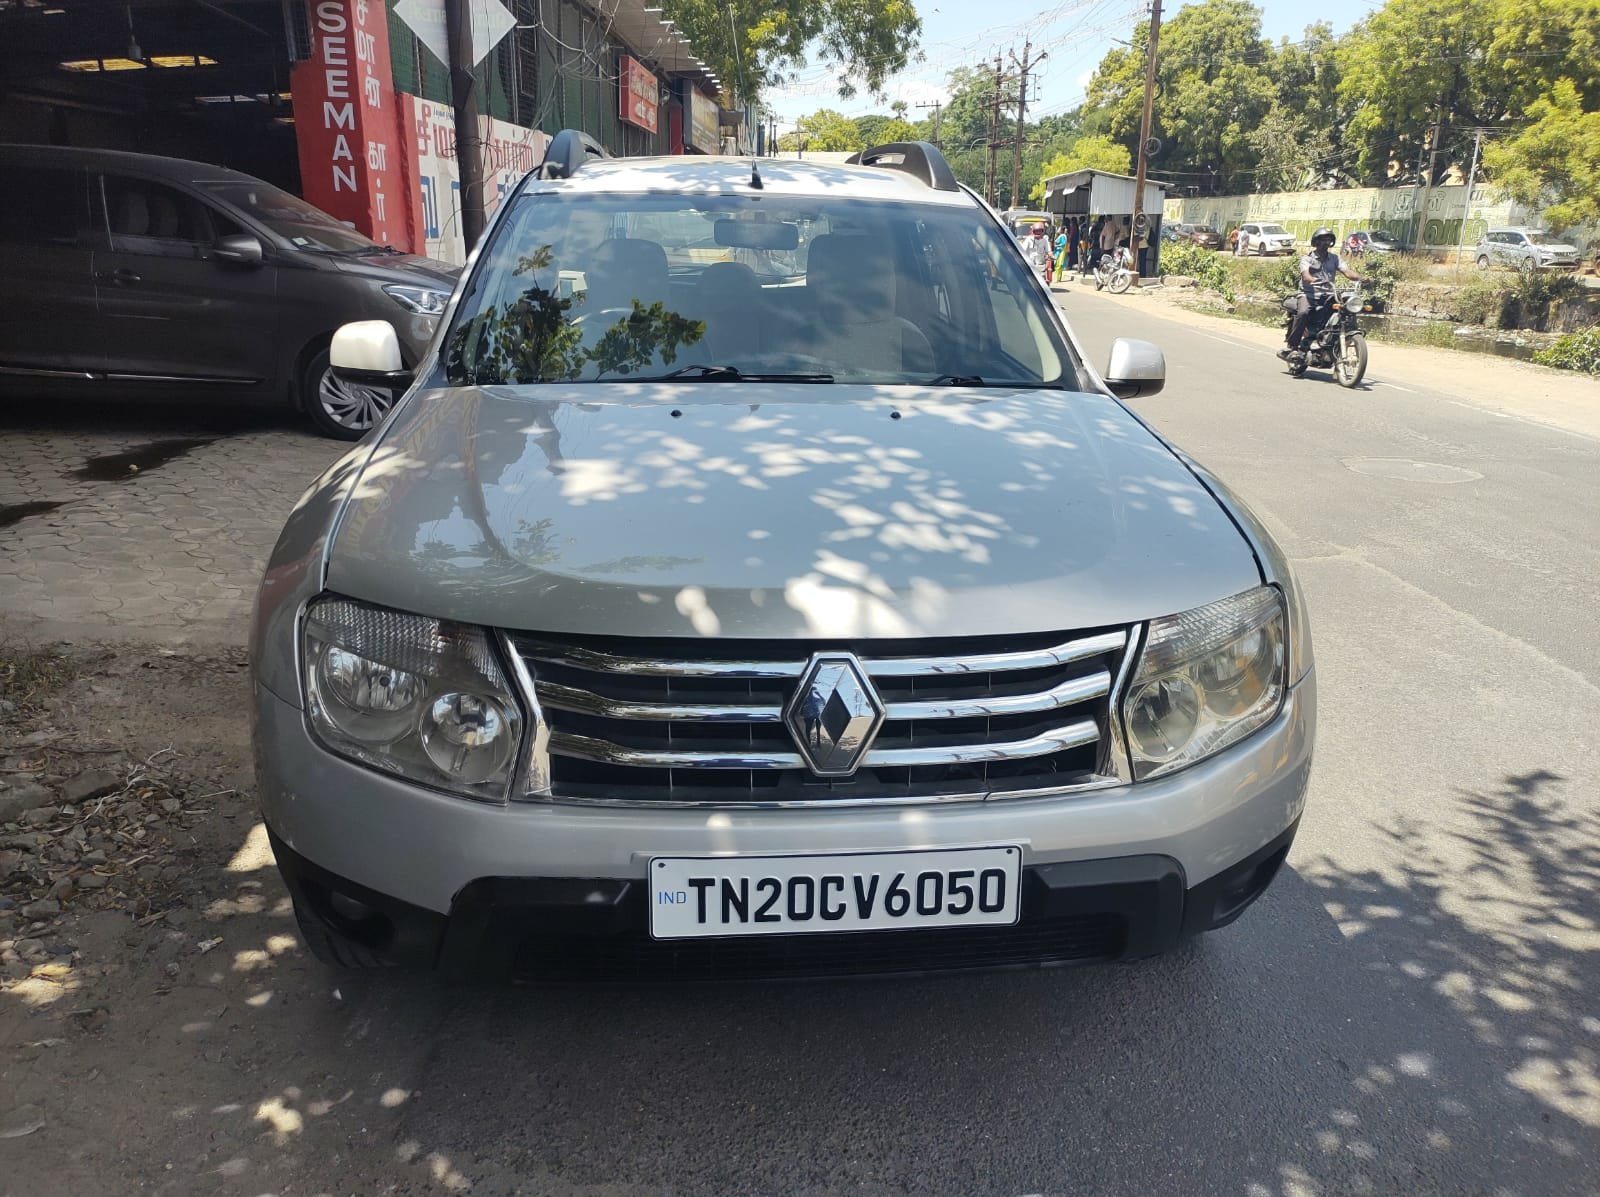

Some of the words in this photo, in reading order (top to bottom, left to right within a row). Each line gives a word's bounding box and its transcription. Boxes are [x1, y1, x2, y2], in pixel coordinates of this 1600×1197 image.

[316, 1, 357, 193] SEEMAN
[659, 891, 687, 904] IND
[688, 868, 1006, 924] TN20CV6050
